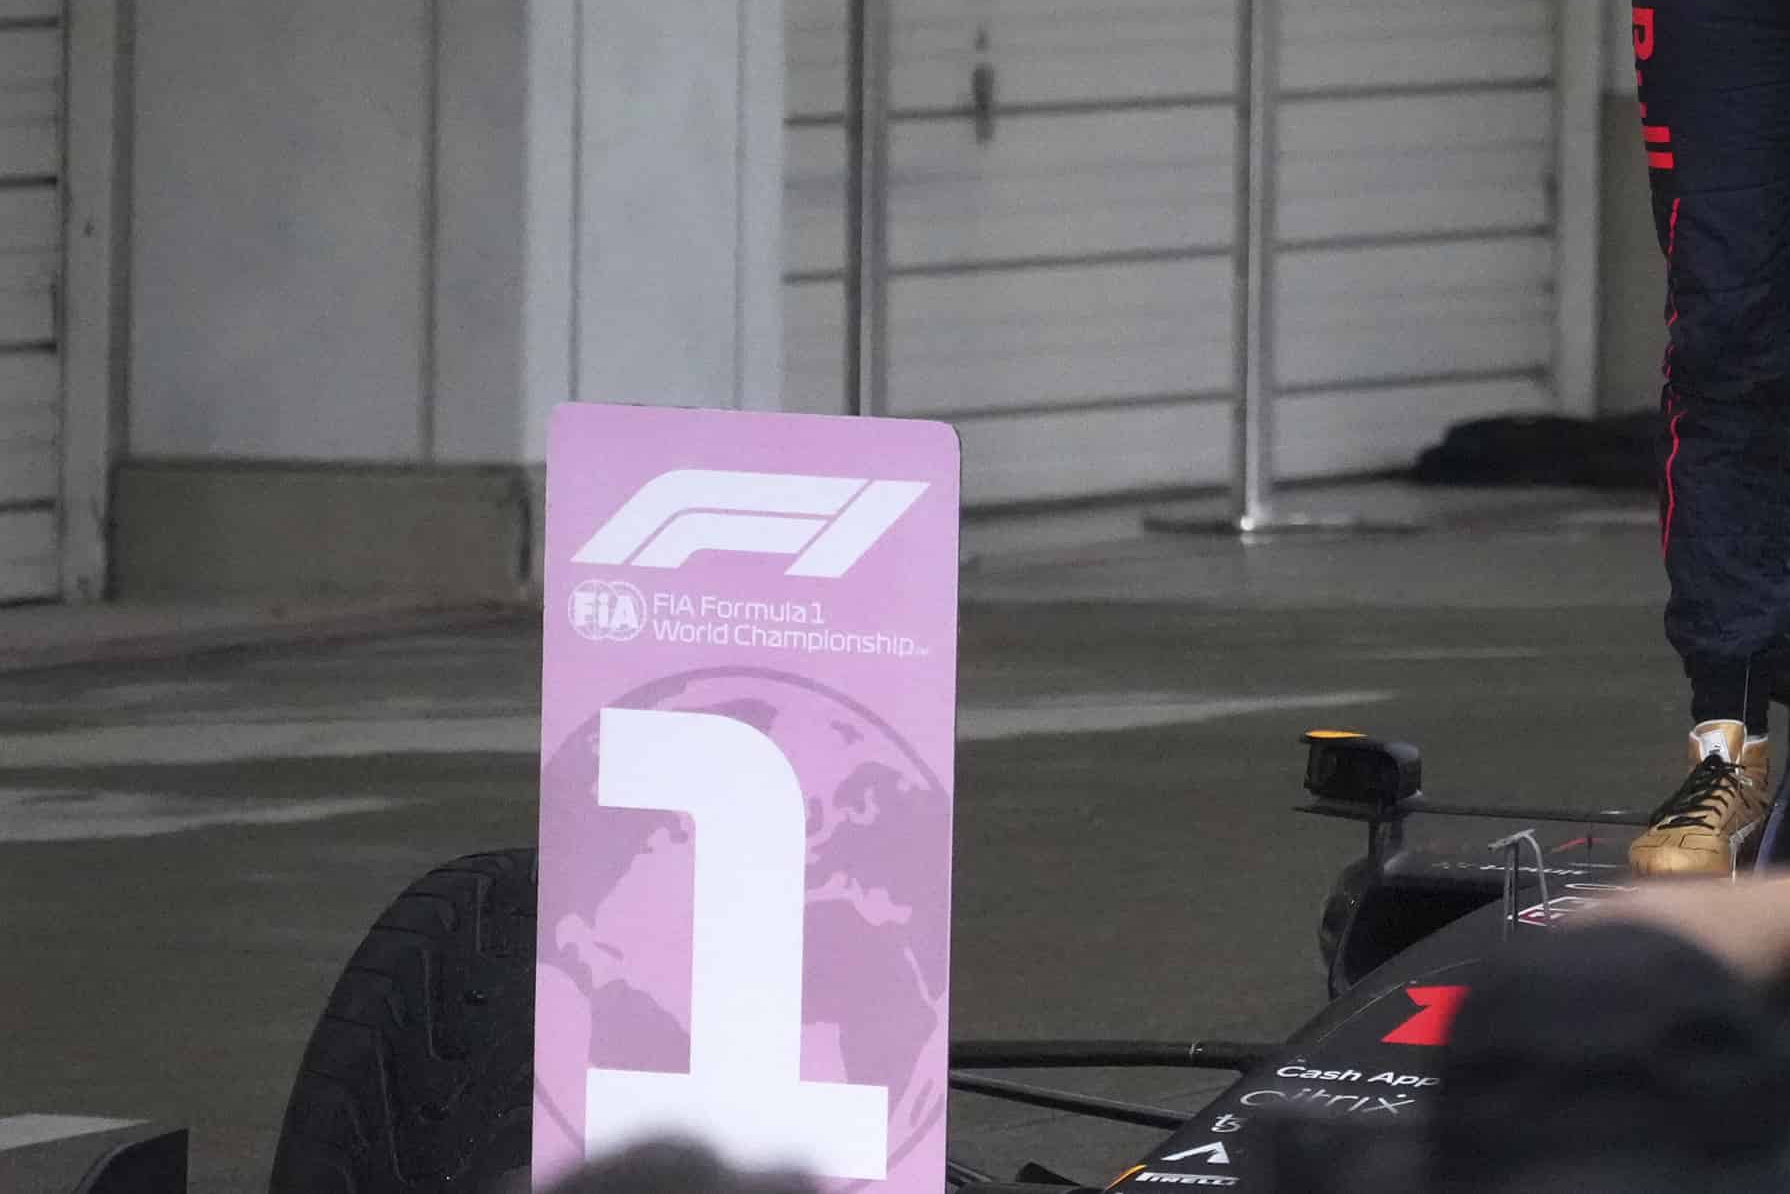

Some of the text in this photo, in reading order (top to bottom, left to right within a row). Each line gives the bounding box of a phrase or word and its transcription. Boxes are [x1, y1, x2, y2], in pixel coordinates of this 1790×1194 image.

[569, 468, 932, 578] F1
[572, 590, 639, 631] FIA
[652, 592, 825, 624] FIA Formula 1
[652, 619, 916, 657] World Championship
[584, 707, 890, 1180] 1
[1276, 1065, 1441, 1088] Cash App
[1135, 1171, 1241, 1187] PIRELLI
